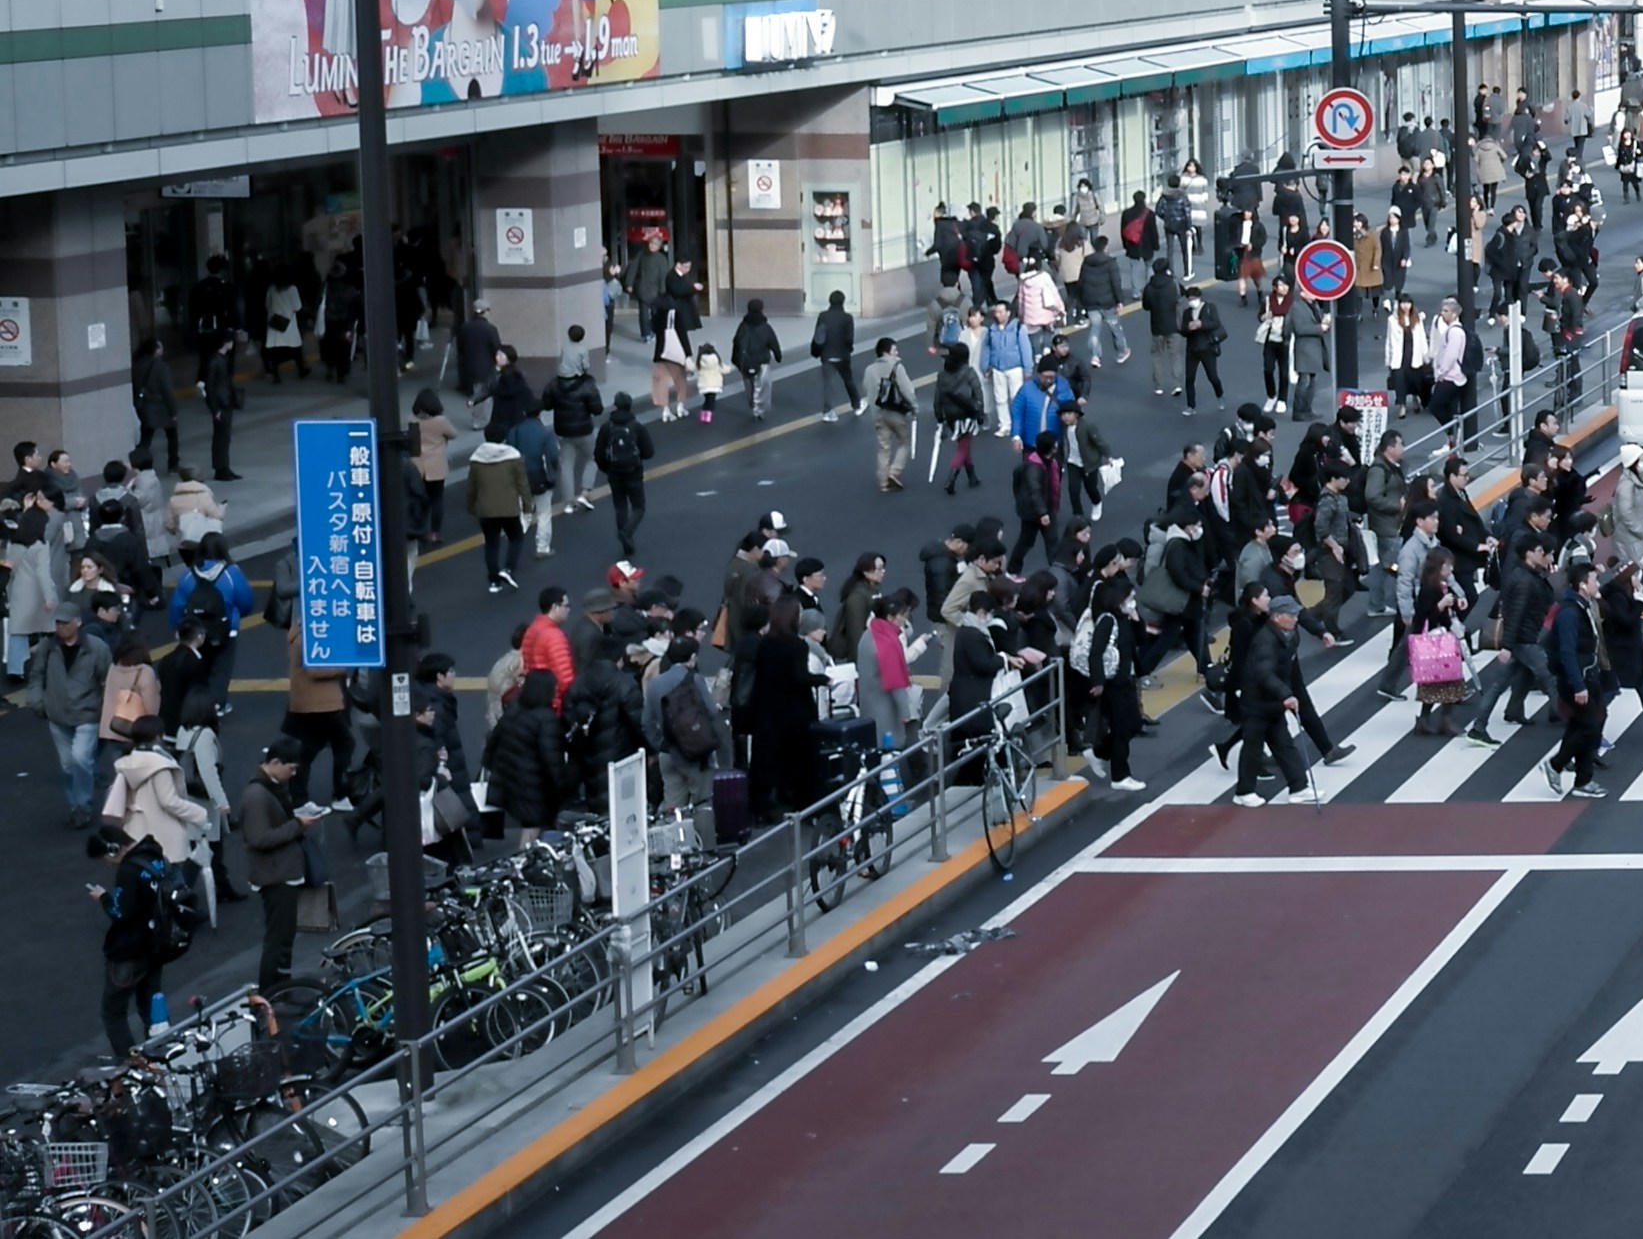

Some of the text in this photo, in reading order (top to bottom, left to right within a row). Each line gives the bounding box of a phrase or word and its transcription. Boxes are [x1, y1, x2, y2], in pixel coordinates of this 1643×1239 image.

[288, 35, 358, 96] LUMIN
[381, 28, 408, 85] THE
[412, 26, 505, 82] BARGAIN
[1345, 394, 1383, 407] お知らせ
[327, 470, 351, 618] バスタ新宿へは
[349, 431, 377, 644] 一般車・原付・自転車は
[307, 555, 330, 659] 入れません
